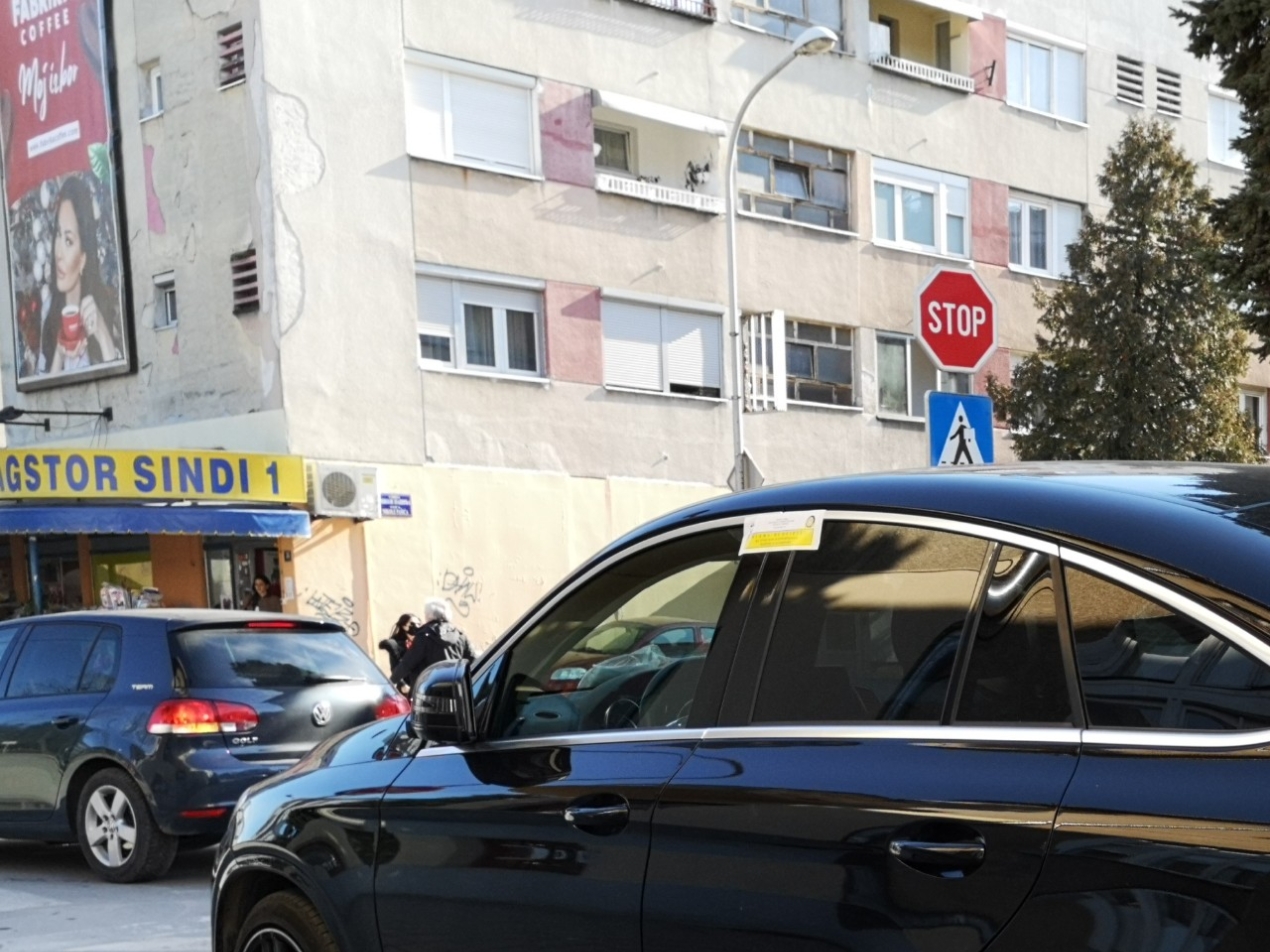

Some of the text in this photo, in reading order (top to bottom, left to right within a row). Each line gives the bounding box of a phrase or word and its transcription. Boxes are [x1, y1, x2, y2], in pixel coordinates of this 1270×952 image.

[20, 8, 70, 46] COFFEE
[928, 300, 986, 338] STOP
[133, 455, 249, 494] SINDI
[265, 461, 279, 494] 1
